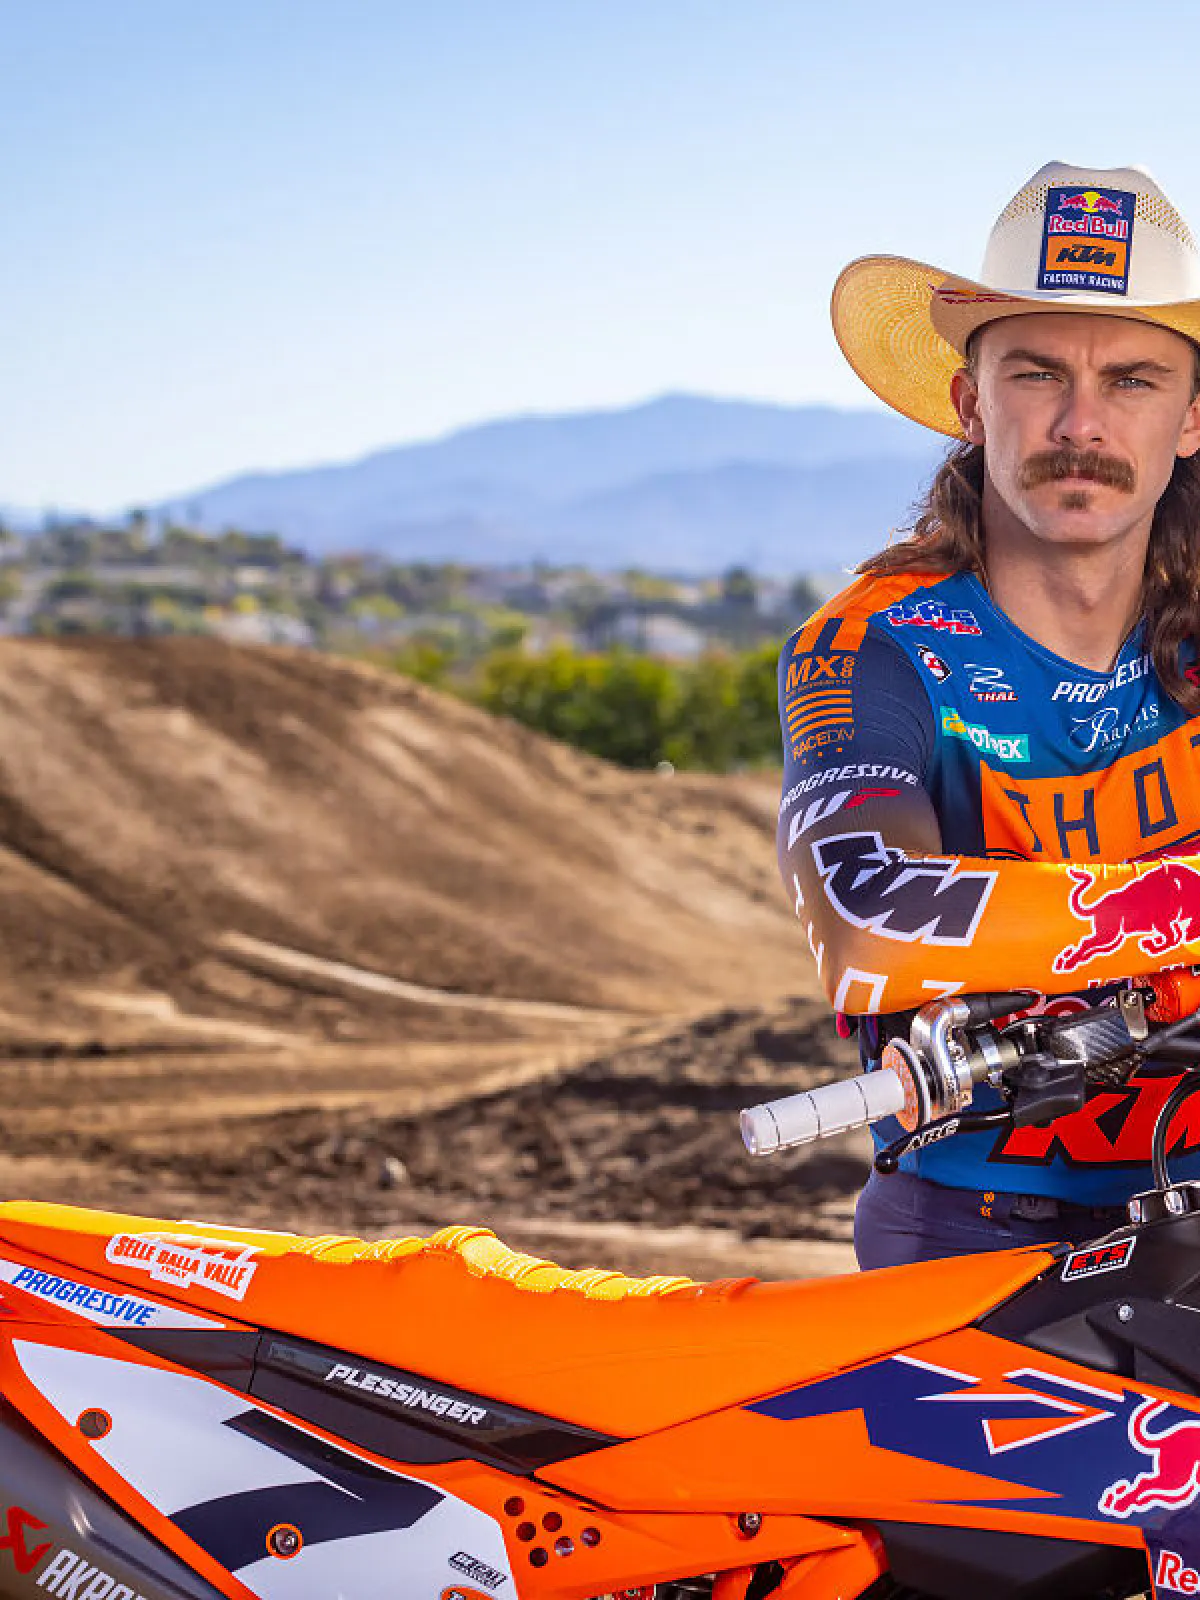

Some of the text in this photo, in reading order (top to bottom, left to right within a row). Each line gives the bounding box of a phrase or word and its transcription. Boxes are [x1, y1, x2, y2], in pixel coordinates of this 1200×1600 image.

[1048, 214, 1129, 239] Red Bull
[1056, 243, 1117, 266] KTM
[1043, 273, 1125, 290] FACTORY RACING
[113, 1235, 248, 1291] SELLE DALLA VALLE
[1071, 1243, 1130, 1271] ETS
[11, 1266, 157, 1327] PROGRESSIVE
[325, 1363, 488, 1425] PLESSINGER
